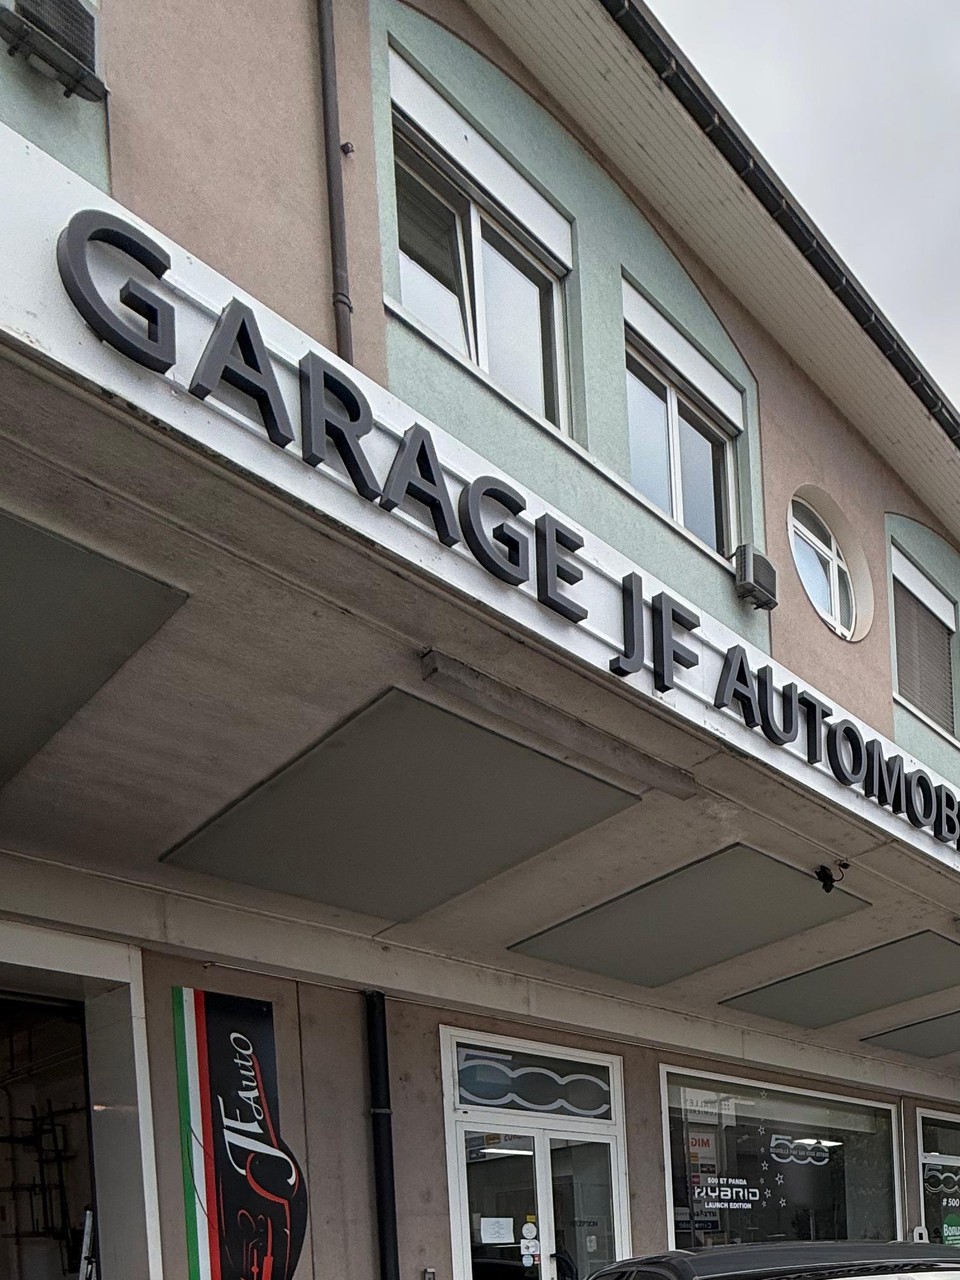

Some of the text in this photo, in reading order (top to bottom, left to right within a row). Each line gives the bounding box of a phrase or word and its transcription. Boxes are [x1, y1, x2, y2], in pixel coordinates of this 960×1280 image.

[57, 209, 588, 624] GARAGE
[609, 572, 701, 693] JF
[770, 1134, 830, 1166] 500
[705, 1201, 728, 1209] LAUNCH
